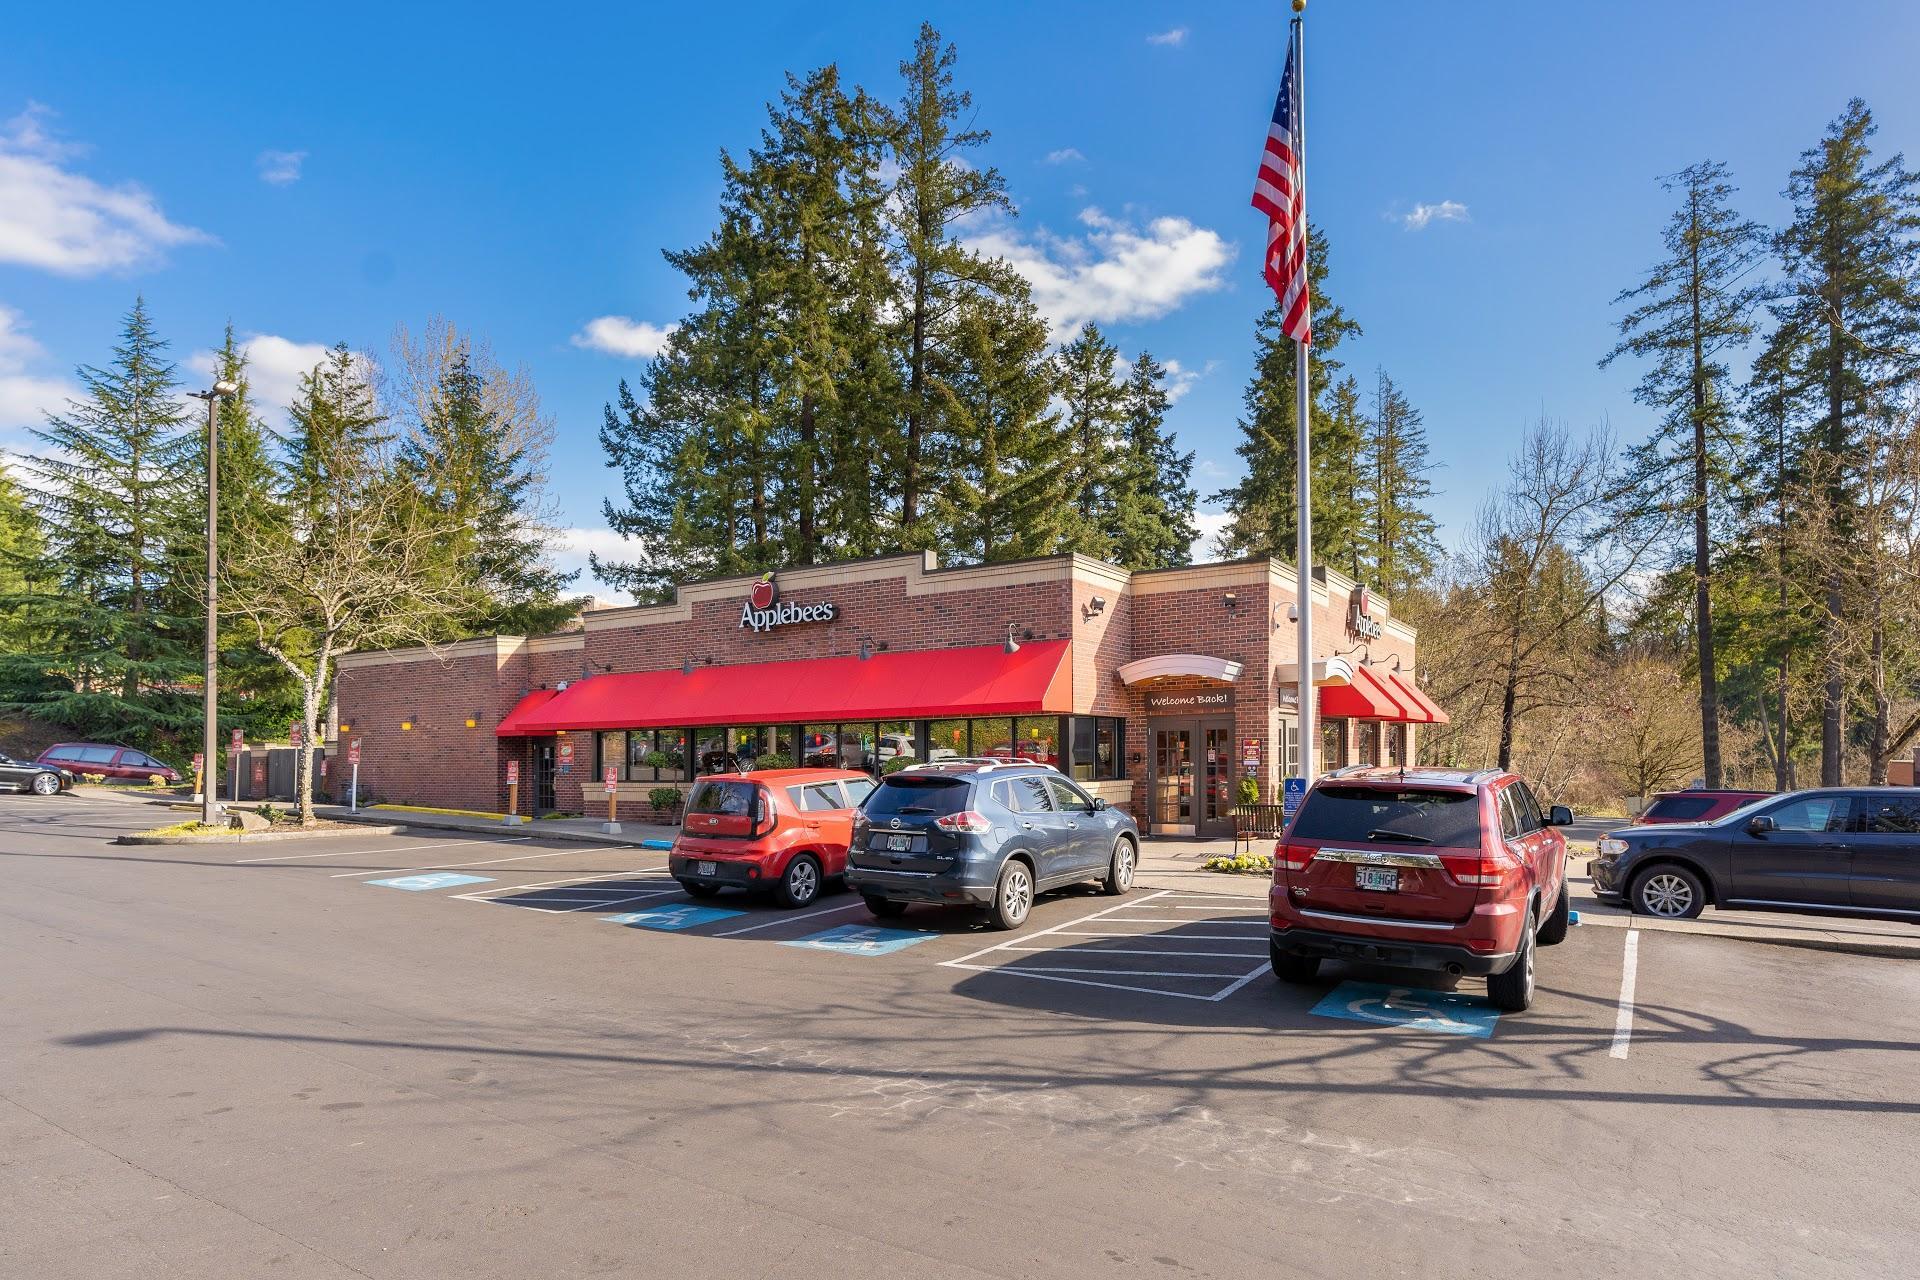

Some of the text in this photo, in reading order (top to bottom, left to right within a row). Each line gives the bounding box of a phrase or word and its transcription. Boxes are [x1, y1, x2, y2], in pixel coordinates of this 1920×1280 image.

[739, 601, 834, 633] Applebee's
[1151, 693, 1227, 706] Welcome Back!
[1356, 871, 1397, 886] 518 HGP
